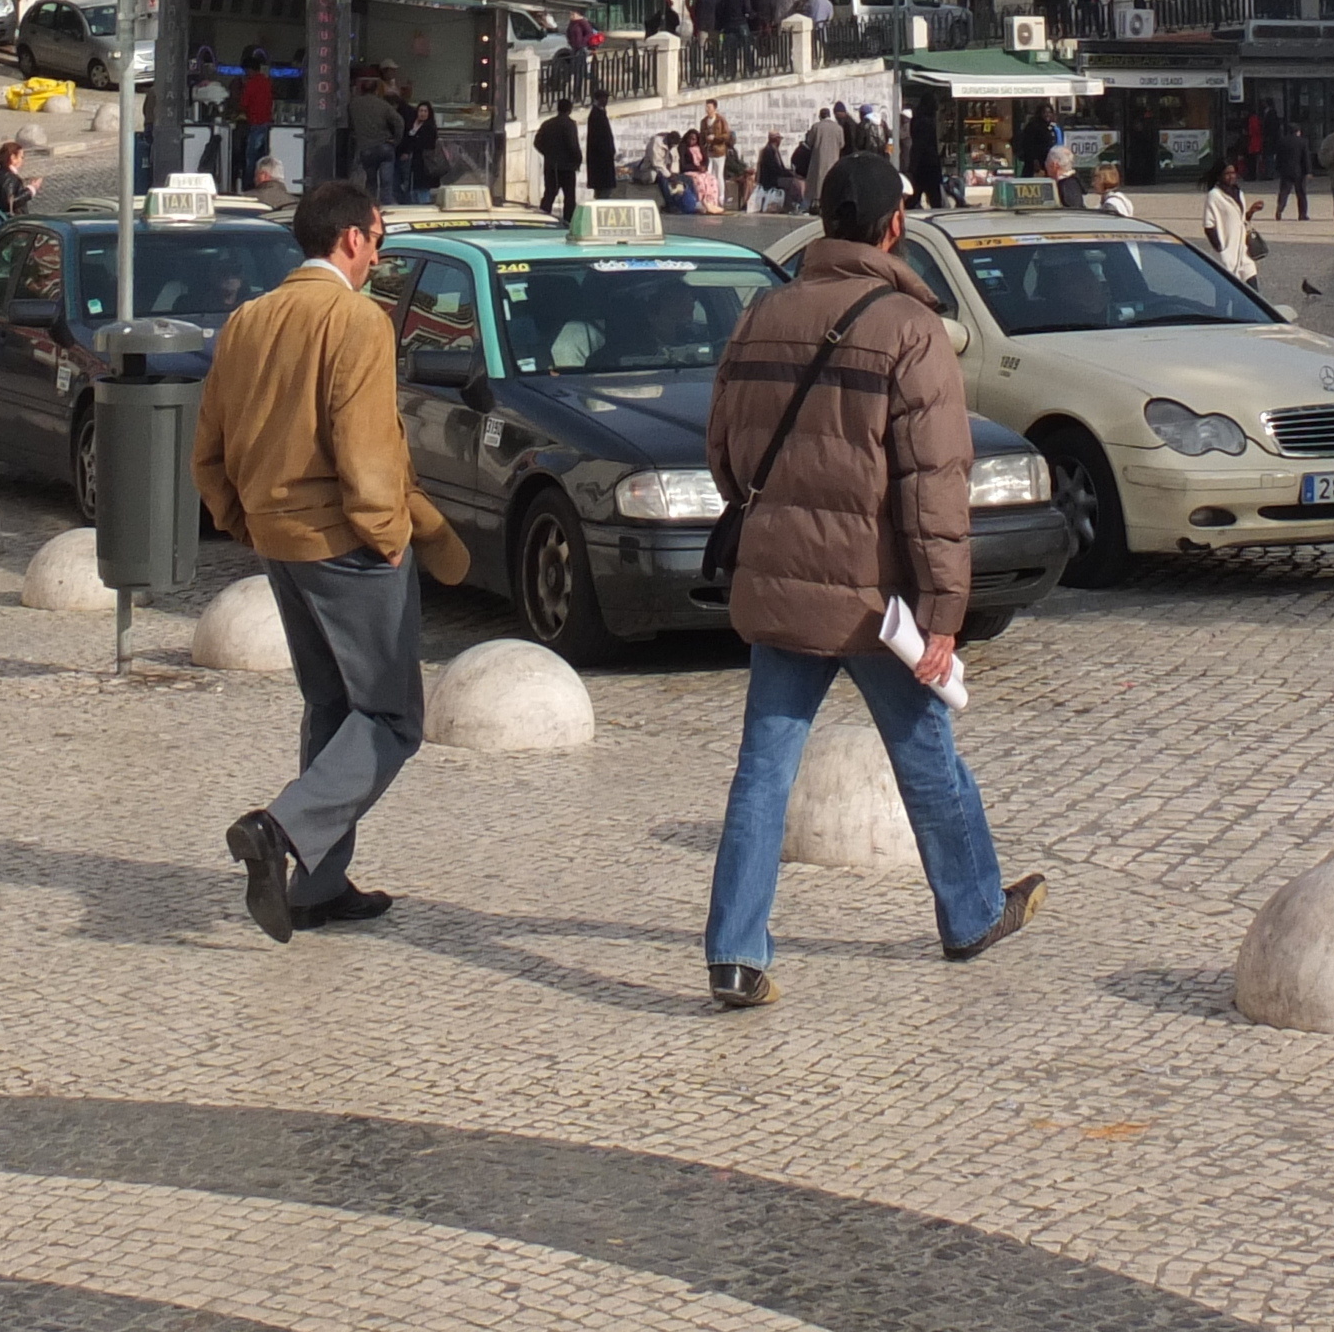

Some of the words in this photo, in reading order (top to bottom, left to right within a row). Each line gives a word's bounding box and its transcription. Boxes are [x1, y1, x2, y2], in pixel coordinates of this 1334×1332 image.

[1070, 142, 1099, 155] OURO
[1173, 141, 1199, 153] OURO
[1015, 185, 1042, 198] TAXI
[165, 194, 192, 206] TAXI
[598, 208, 635, 226] TAXI
[497, 263, 531, 274] 240
